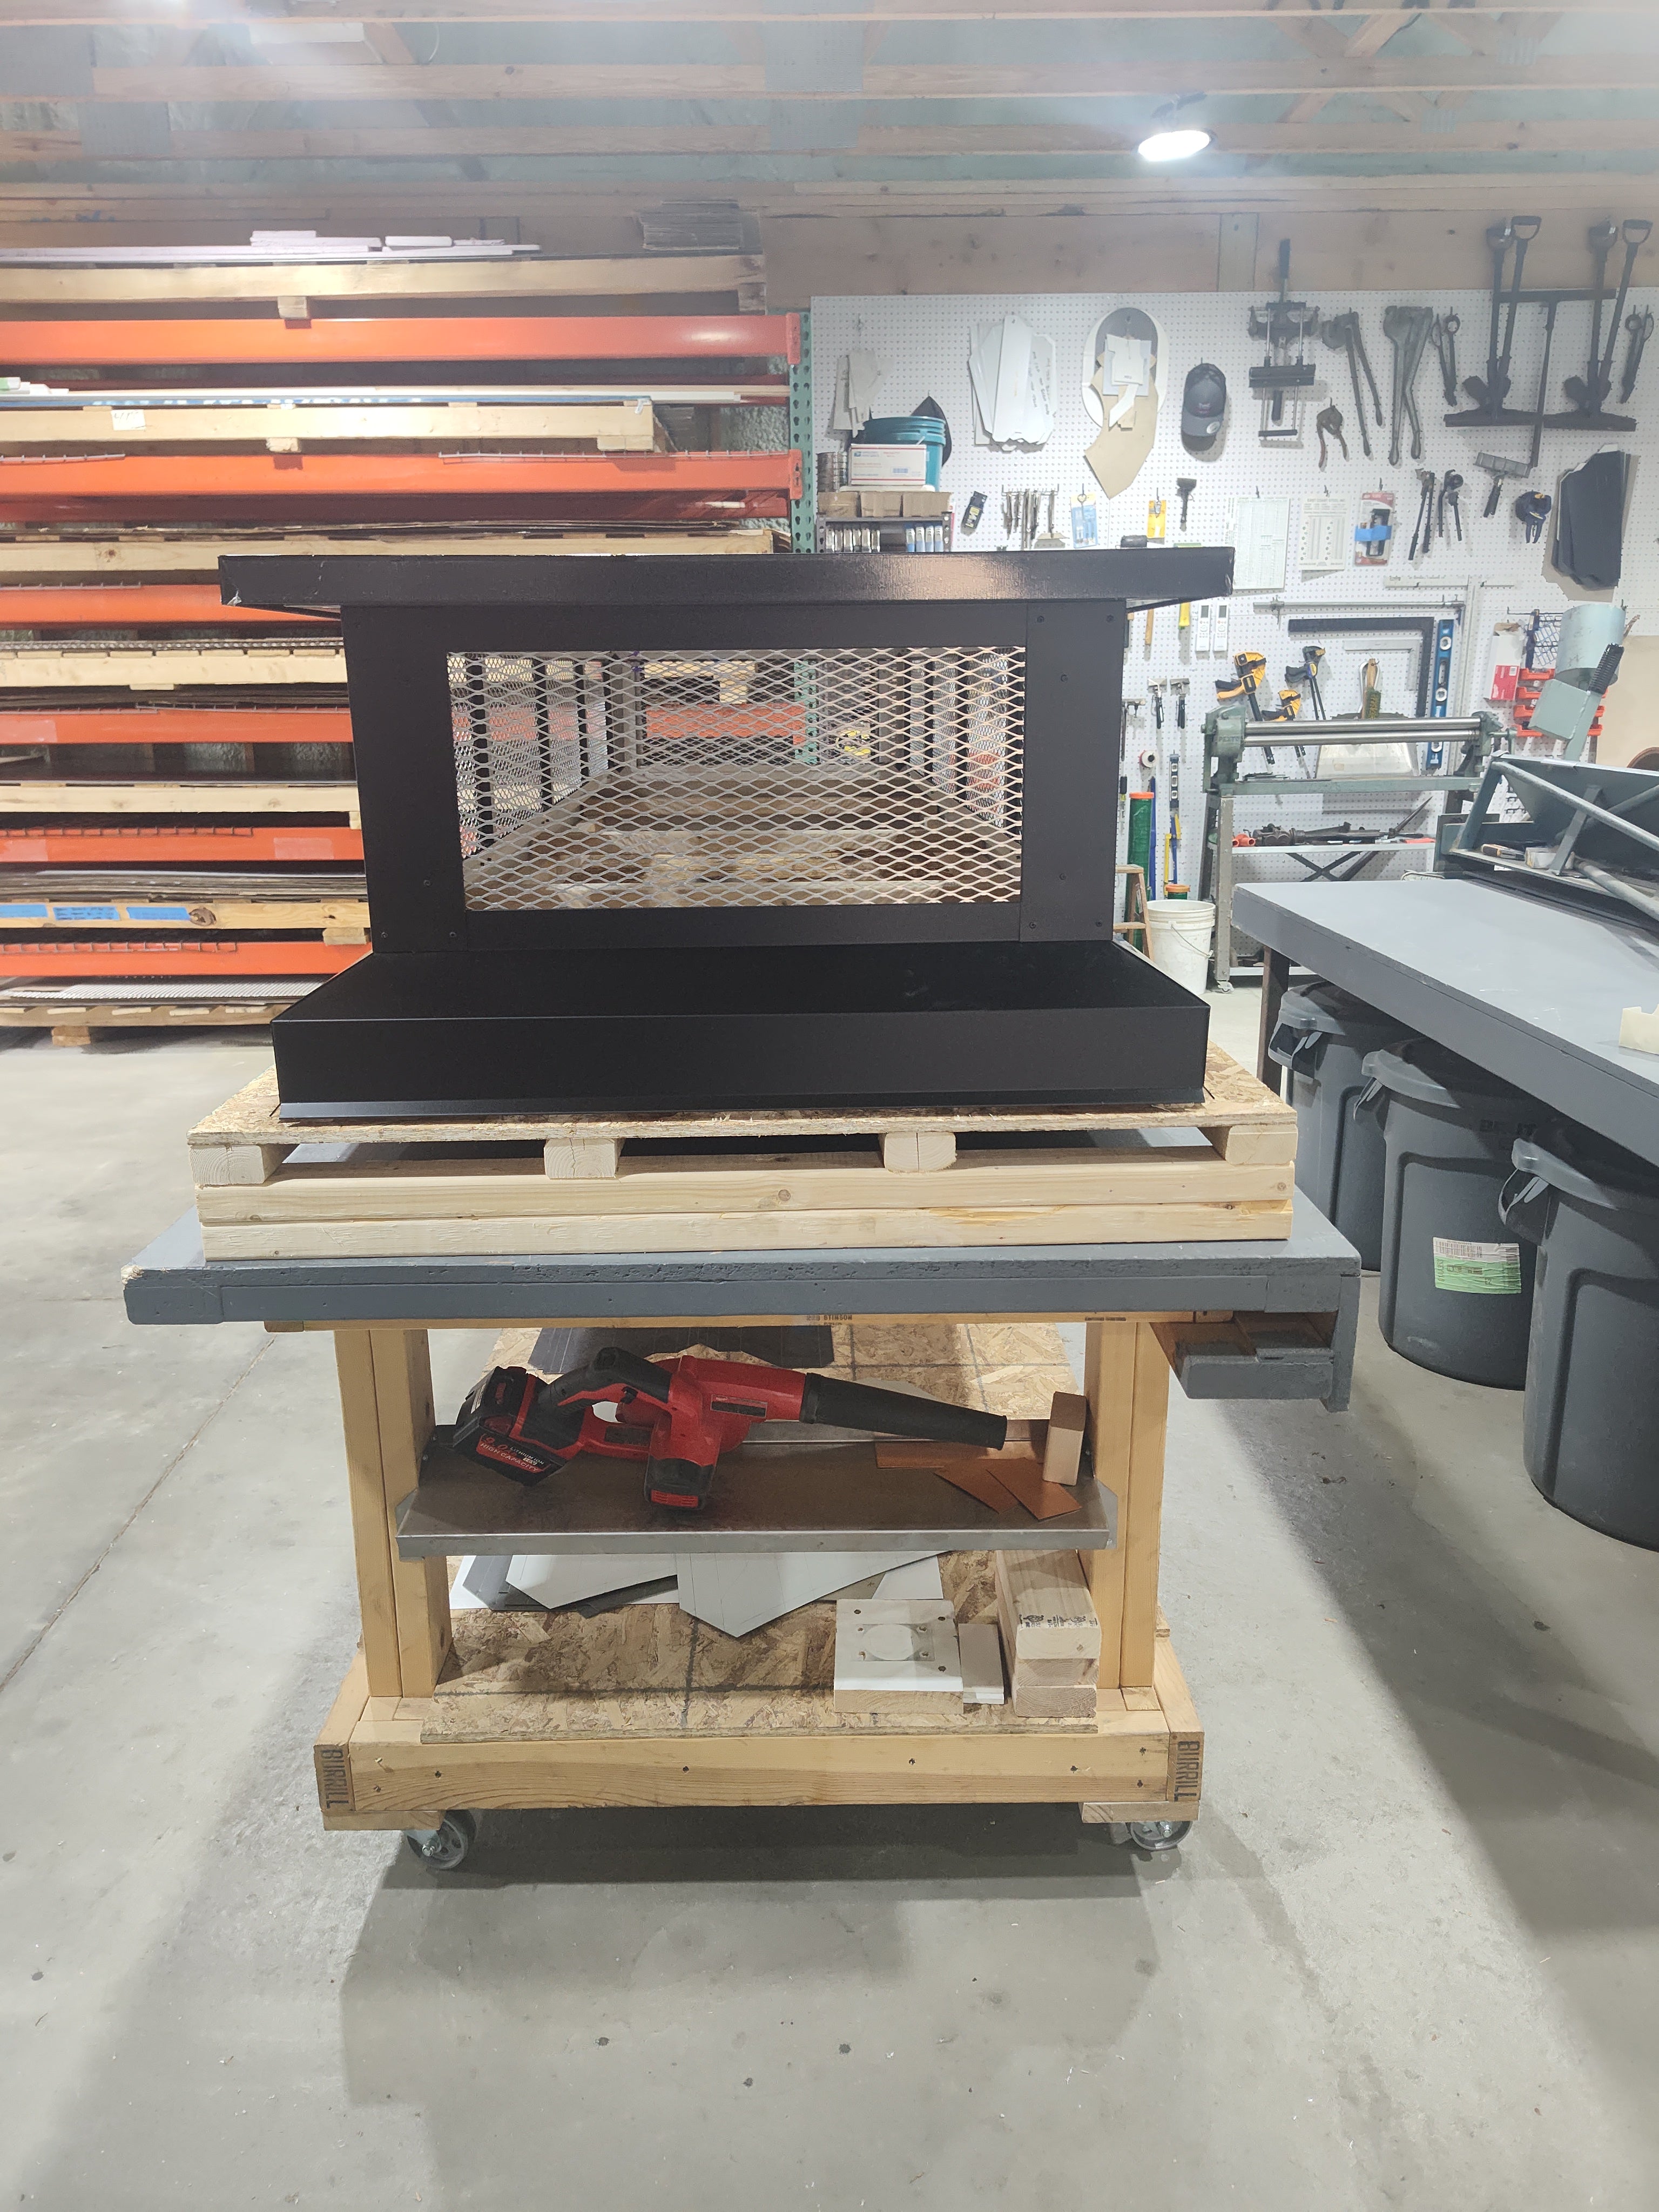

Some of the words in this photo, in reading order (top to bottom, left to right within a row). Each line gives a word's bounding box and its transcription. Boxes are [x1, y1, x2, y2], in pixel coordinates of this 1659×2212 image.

[480, 1442, 500, 1454] HIGH
[500, 1452, 538, 1472] CAPACITY
[509, 1447, 534, 1460] LITHIUM
[321, 1749, 349, 1809] BURRILL
[1174, 1741, 1200, 1803] BURRILL
